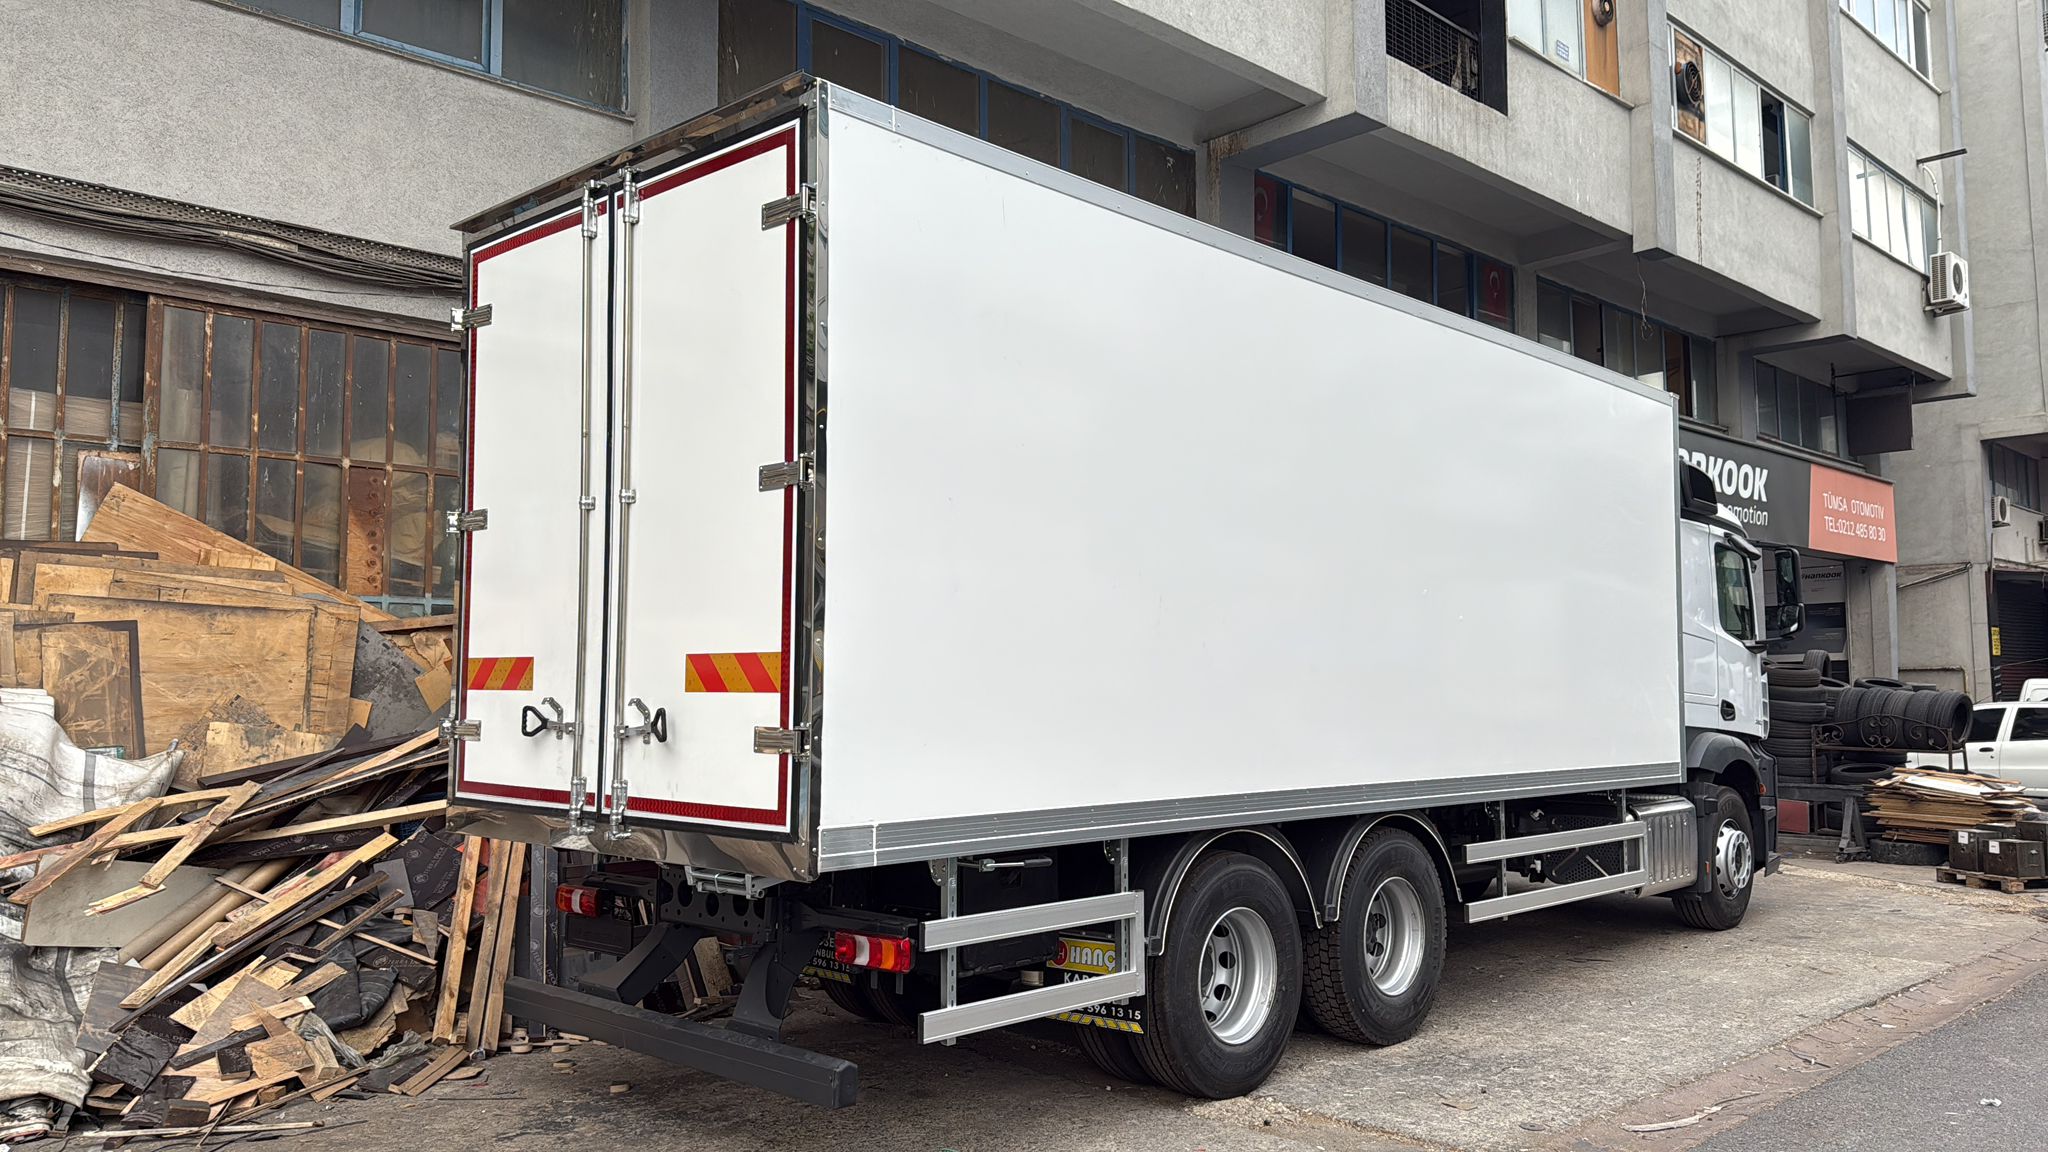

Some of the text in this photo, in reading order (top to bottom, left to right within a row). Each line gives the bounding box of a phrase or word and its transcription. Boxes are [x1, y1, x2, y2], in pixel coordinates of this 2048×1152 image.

[1679, 448, 1768, 502] KOOK
[1823, 491, 1848, 512] TÜMSA
[1878, 527, 1886, 542] 30
[1087, 1004, 1141, 1020] 596 13 15
